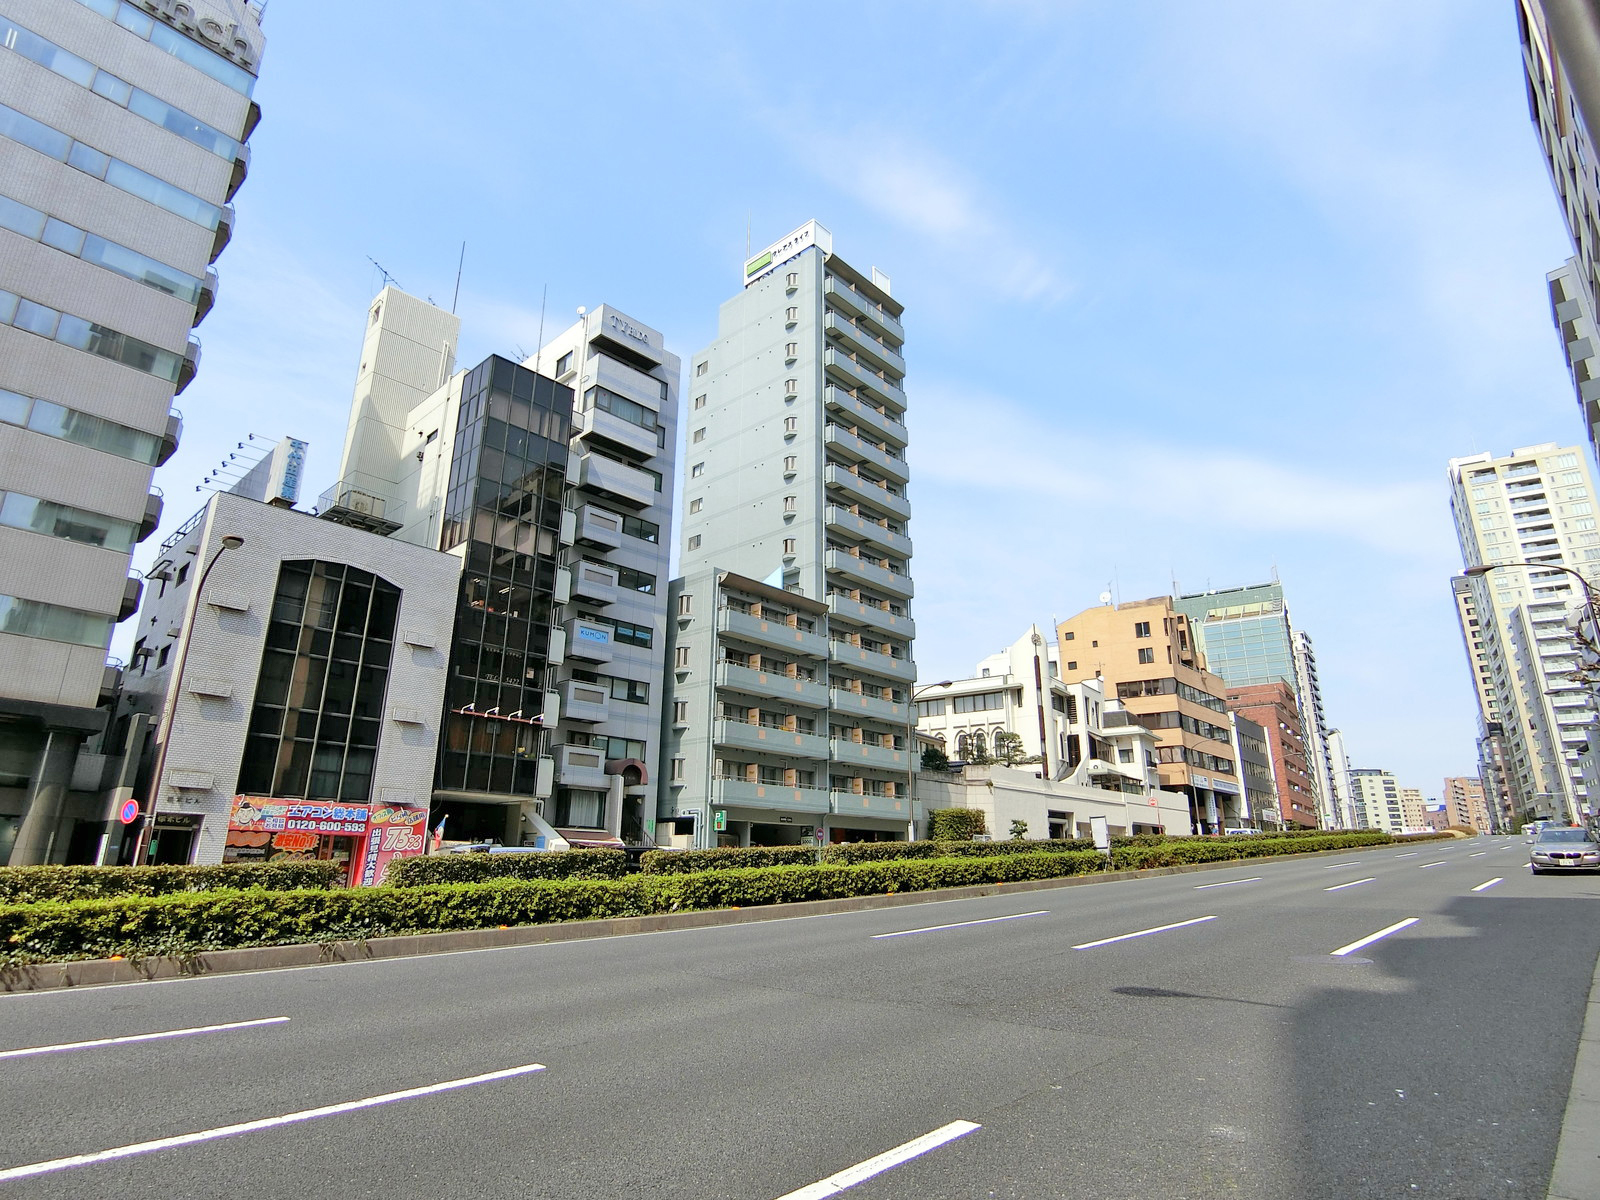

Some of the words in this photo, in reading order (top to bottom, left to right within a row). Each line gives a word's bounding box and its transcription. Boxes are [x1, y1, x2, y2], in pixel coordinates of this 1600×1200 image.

[142, 0, 254, 67] nch
[580, 629, 607, 640] KUMON
[287, 805, 369, 821] エアコン総本舗
[286, 819, 366, 832] 0120-600-593
[382, 826, 423, 851] 75%
